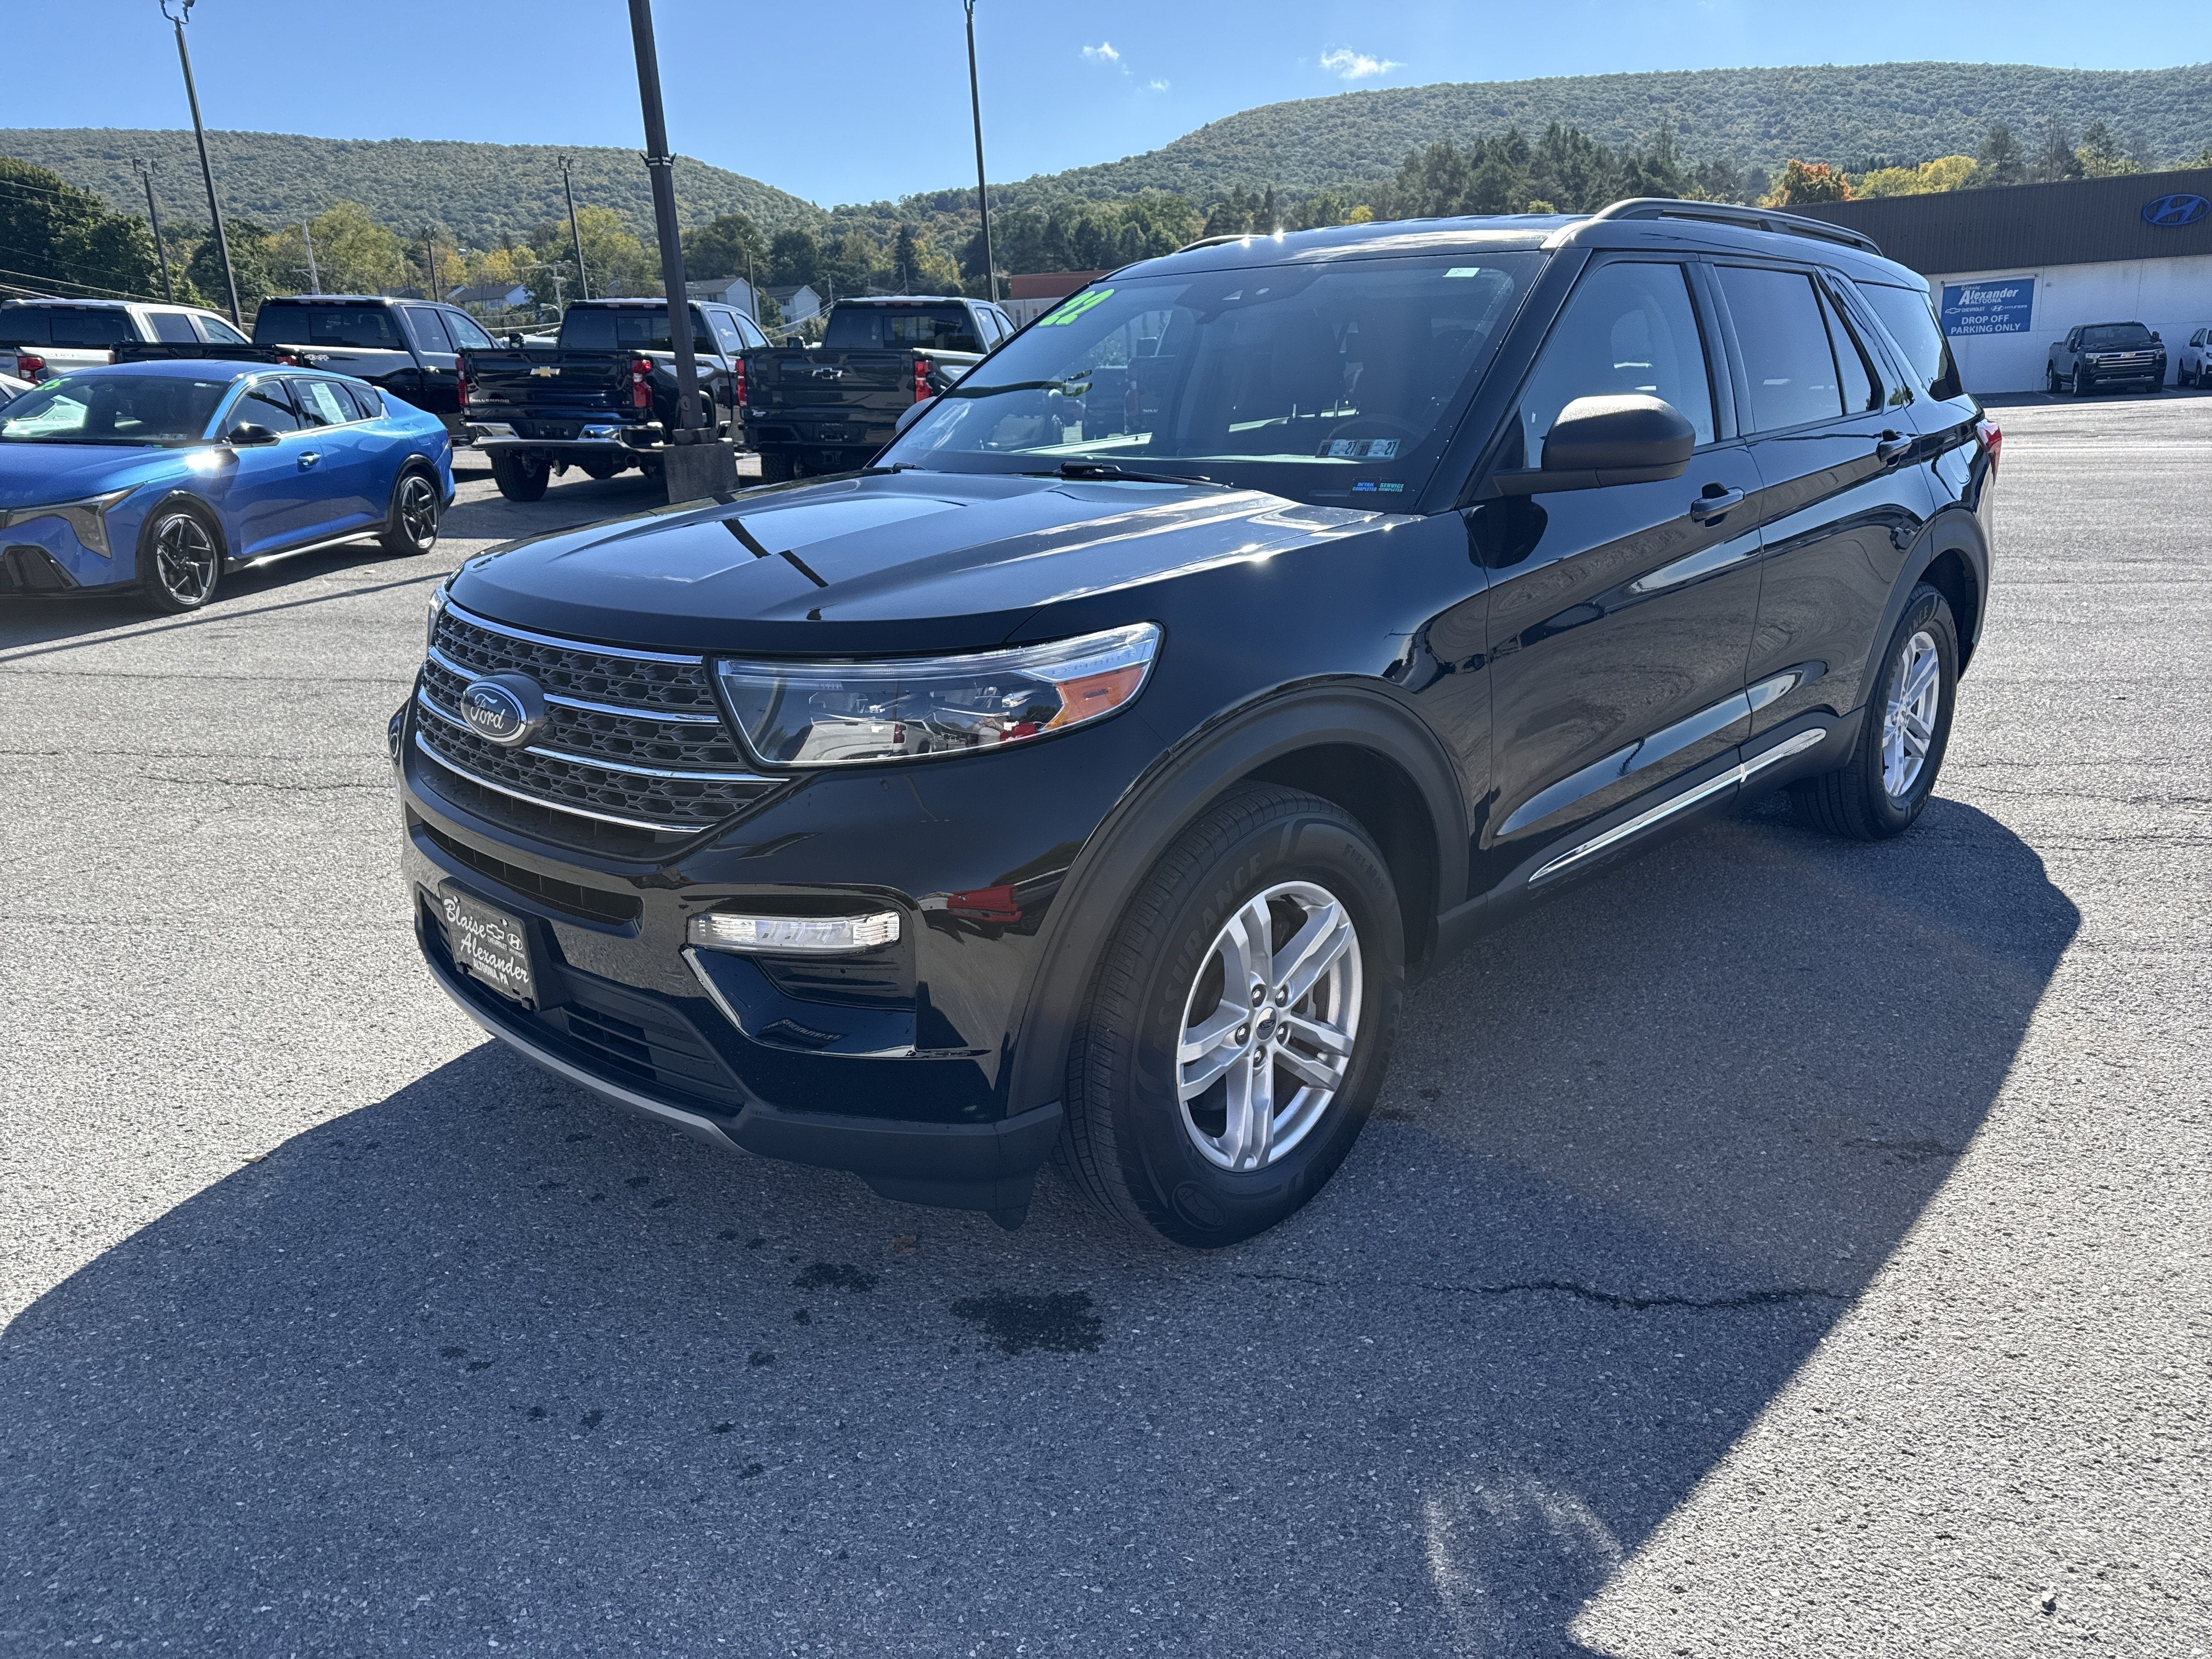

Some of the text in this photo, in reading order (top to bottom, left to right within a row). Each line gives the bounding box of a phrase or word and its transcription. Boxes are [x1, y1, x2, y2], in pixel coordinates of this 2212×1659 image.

[1038, 289, 1115, 326] 22
[1958, 288, 2019, 305] Alexander
[1950, 323, 2021, 334] PARKING ONLY
[1961, 314, 2010, 325] DROP OFF
[1320, 442, 1357, 455] 10 27
[1358, 442, 1397, 456] 10 27
[470, 693, 506, 730] Ford
[444, 899, 487, 938] Blaise
[487, 935, 507, 951] CHEVROLET
[1153, 851, 1262, 1058] ASSURANCE
[460, 933, 529, 983] Alexander
[473, 957, 509, 986] ALTOONA, PA
